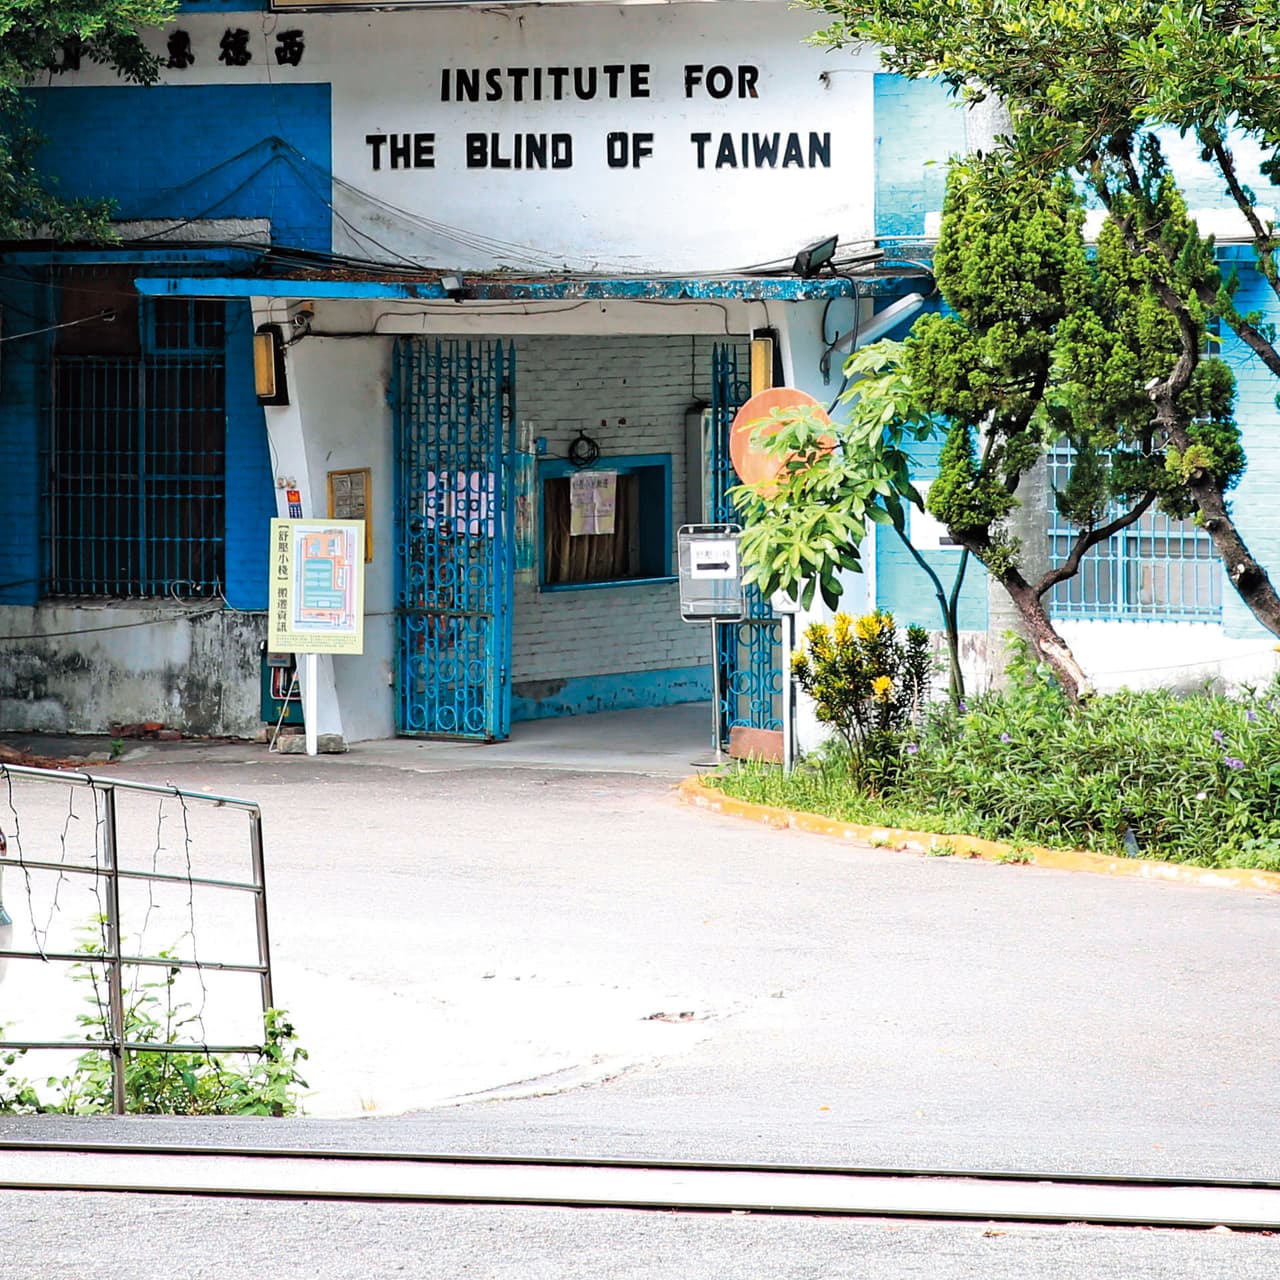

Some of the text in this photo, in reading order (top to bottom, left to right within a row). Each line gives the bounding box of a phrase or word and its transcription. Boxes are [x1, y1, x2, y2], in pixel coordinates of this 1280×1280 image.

[440, 64, 760, 103] INSTITUTE FOR
[366, 131, 831, 169] THE BLIND OF TAIWAN
